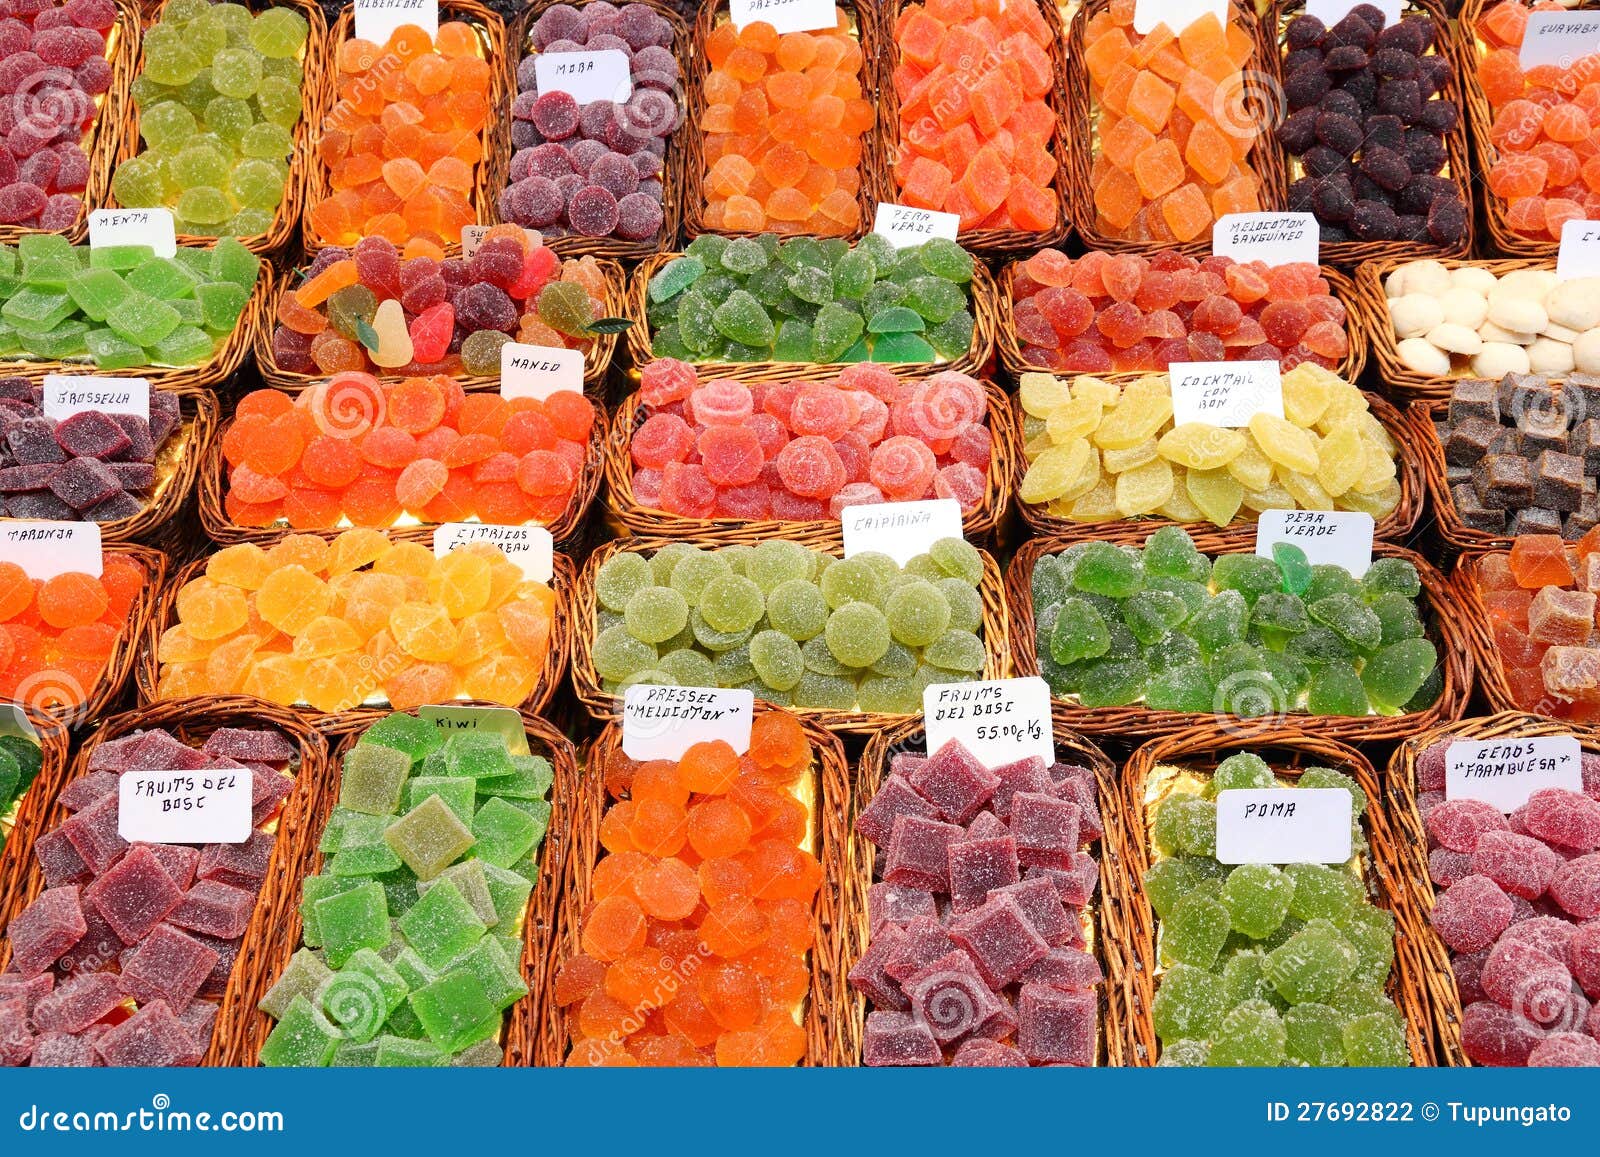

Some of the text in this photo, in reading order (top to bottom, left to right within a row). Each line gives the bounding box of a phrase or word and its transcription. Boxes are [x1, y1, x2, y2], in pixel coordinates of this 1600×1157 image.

[99, 212, 149, 228] MENTA
[893, 209, 931, 222] PERA
[890, 221, 934, 234] VERDE
[510, 357, 560, 372] MANGO
[57, 390, 130, 406] GROSSELLA
[1203, 387, 1231, 398] CON
[1198, 398, 1228, 409] BON
[1284, 512, 1325, 524] PERA
[7, 528, 73, 542] TARONJA
[456, 526, 528, 540] CITRICOS
[1284, 524, 1338, 537] VERDE
[646, 688, 718, 704] PRESSEC
[939, 686, 1003, 703] FRUITS
[936, 701, 1014, 721] DEL BOSC
[135, 774, 236, 797] FRUITS DEL
[162, 796, 206, 812] BOSC
[1244, 801, 1297, 819] POMA
